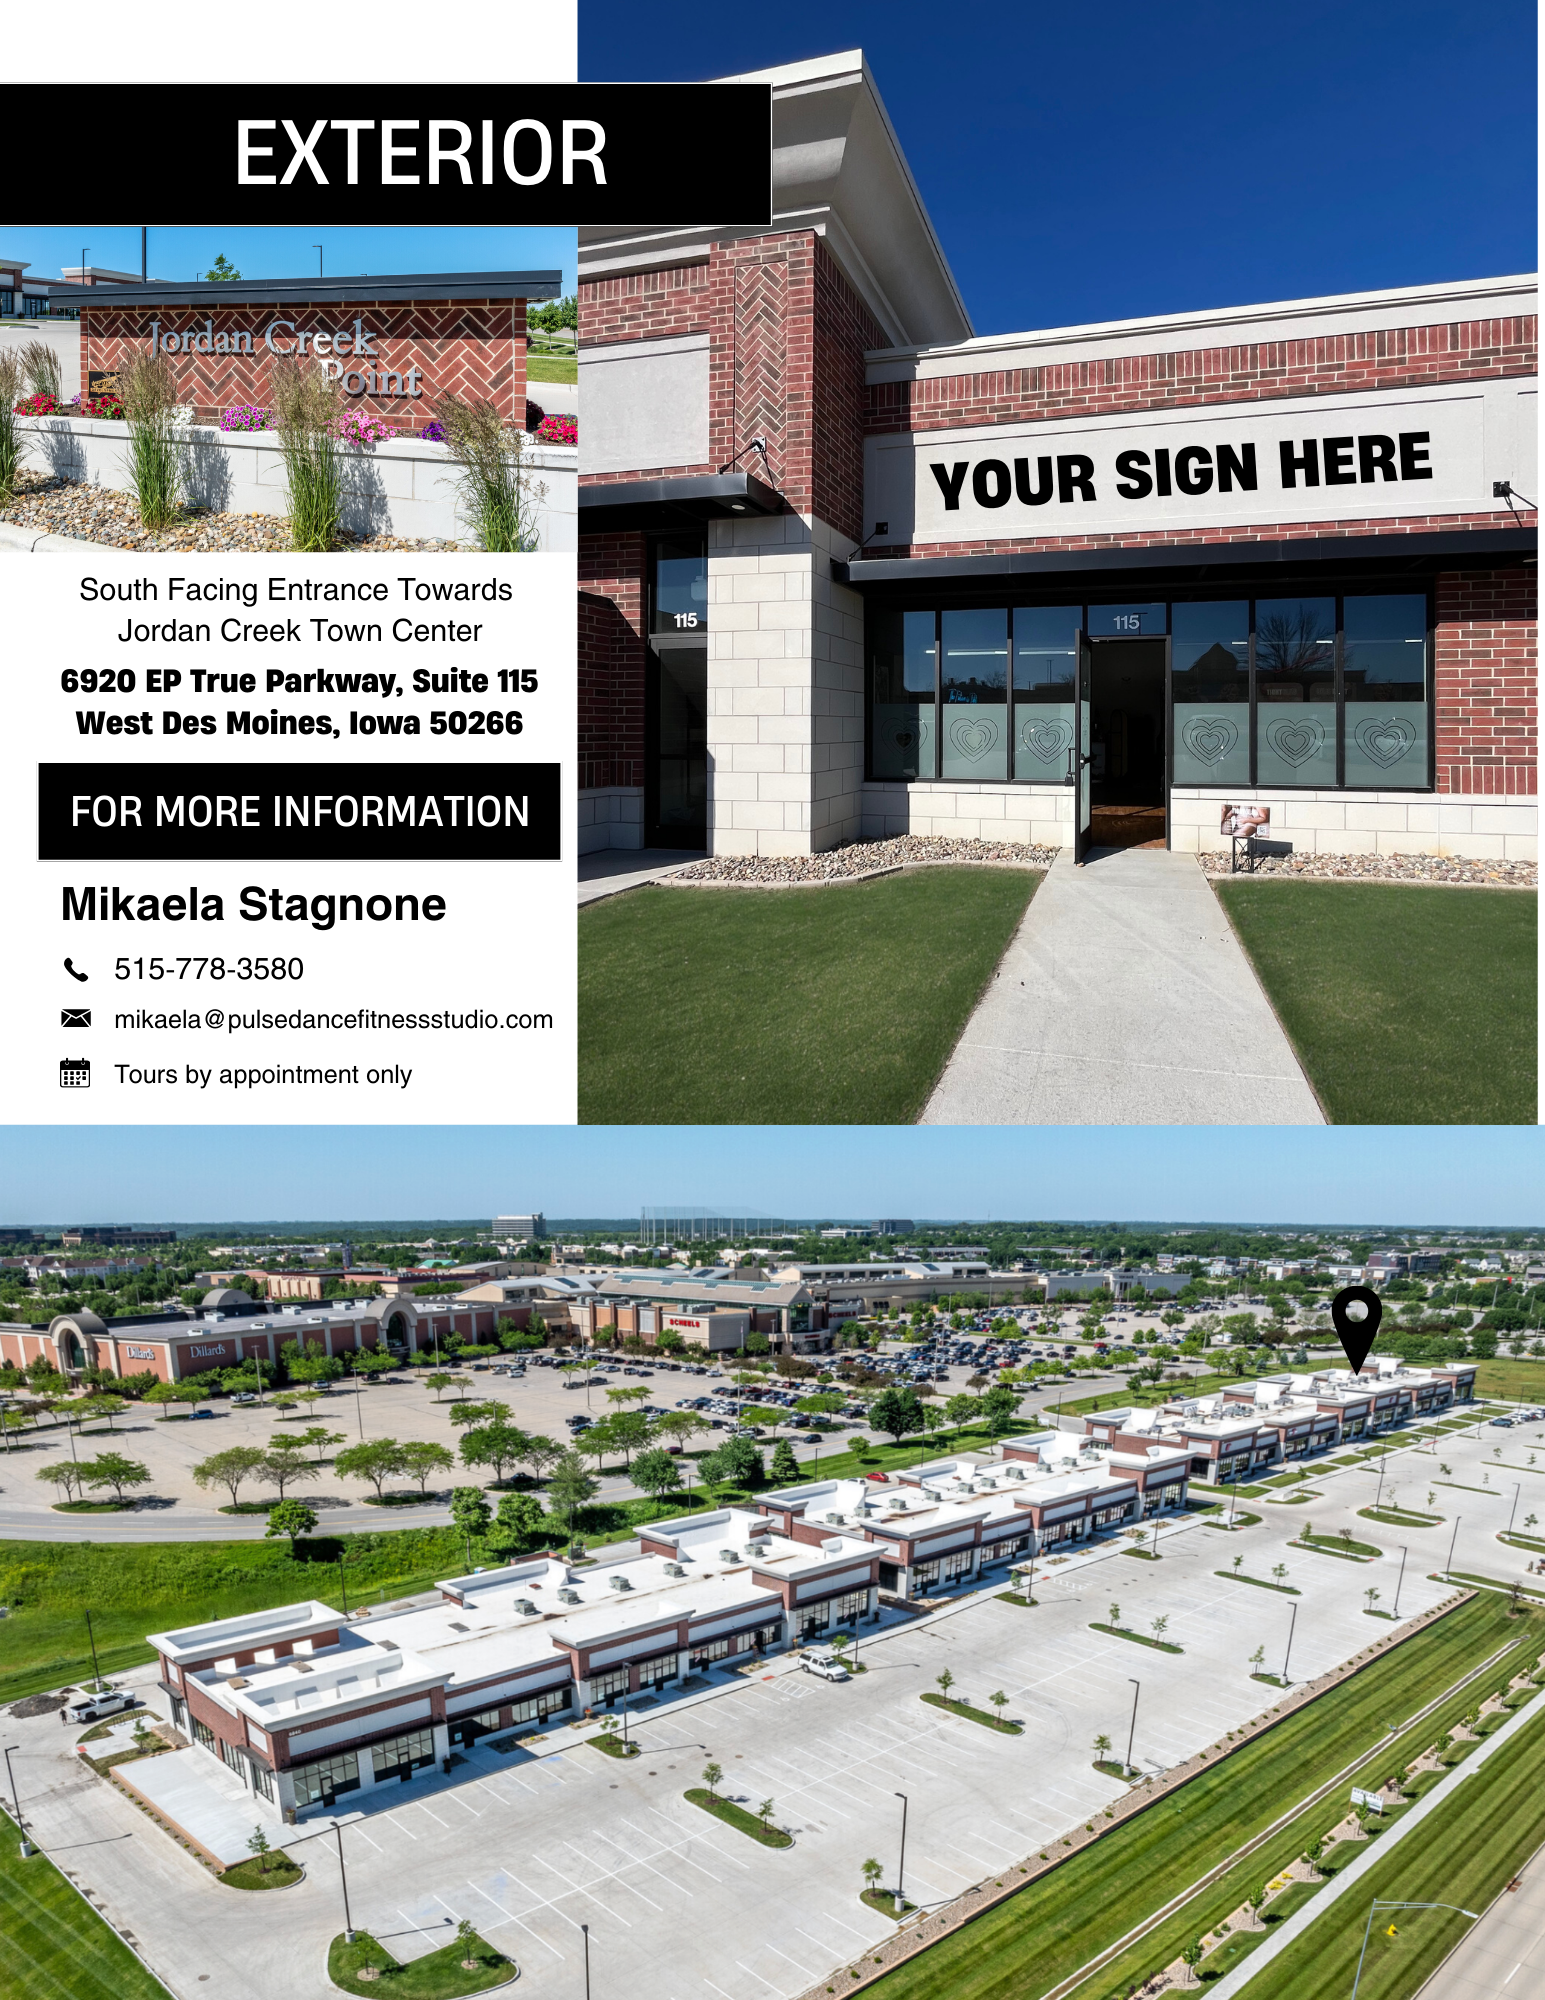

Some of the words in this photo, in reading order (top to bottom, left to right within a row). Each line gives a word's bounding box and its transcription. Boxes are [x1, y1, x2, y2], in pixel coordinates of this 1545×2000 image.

[149, 319, 255, 359] Jordan
[265, 318, 380, 358] Creek
[317, 359, 423, 397] Point
[673, 612, 698, 628] 115
[1113, 614, 1140, 630] 115
[669, 1318, 700, 1328] SCHEELS
[190, 1343, 226, 1359] Dillard's
